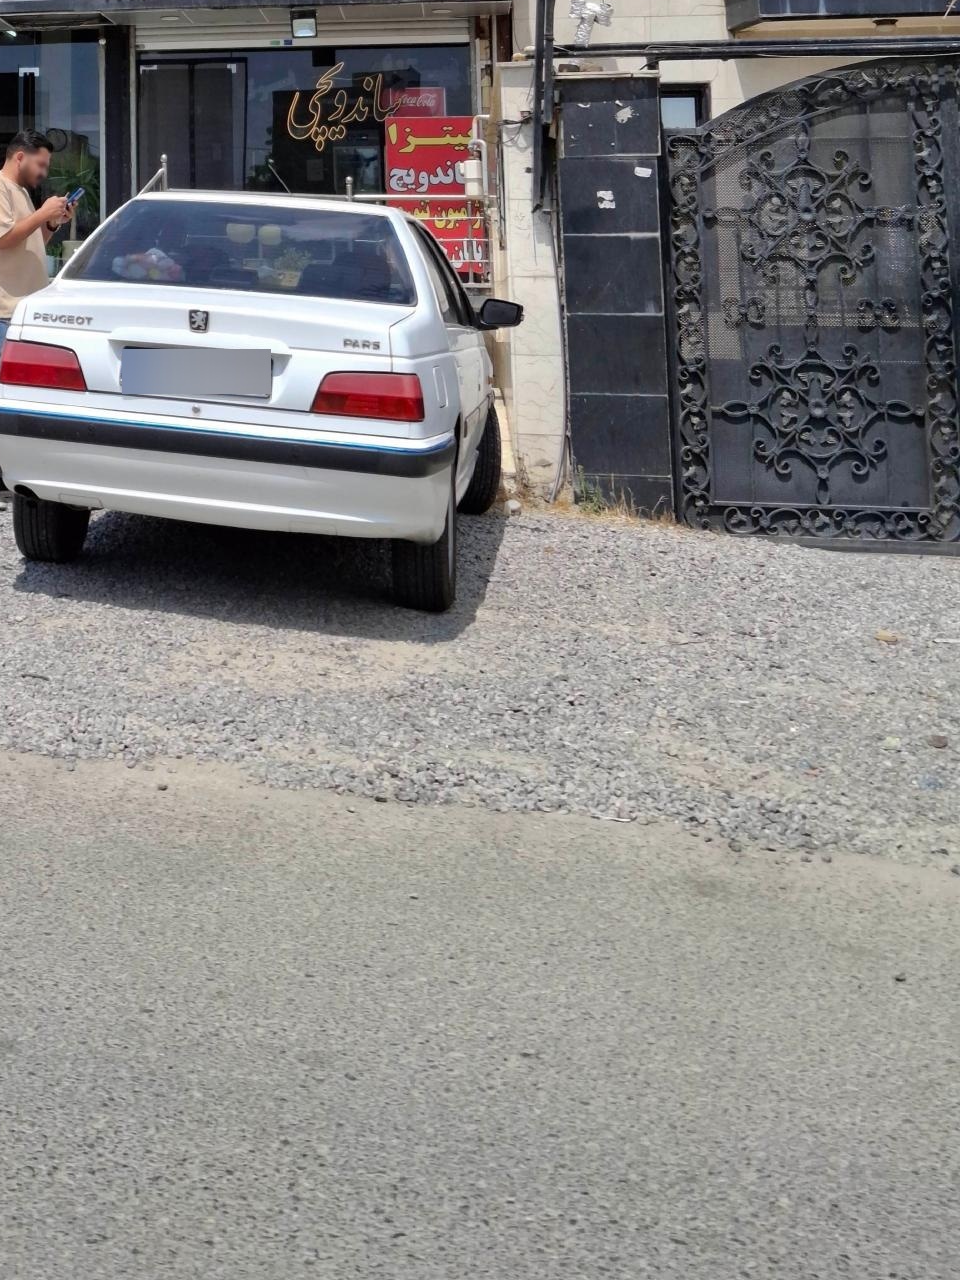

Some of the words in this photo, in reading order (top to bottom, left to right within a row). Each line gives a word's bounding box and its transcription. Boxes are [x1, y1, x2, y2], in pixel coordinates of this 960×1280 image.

[388, 123, 472, 153] یتزا
[390, 160, 465, 192] اندویچ
[34, 312, 93, 325] PEUGEOT
[343, 339, 380, 350] PARS
